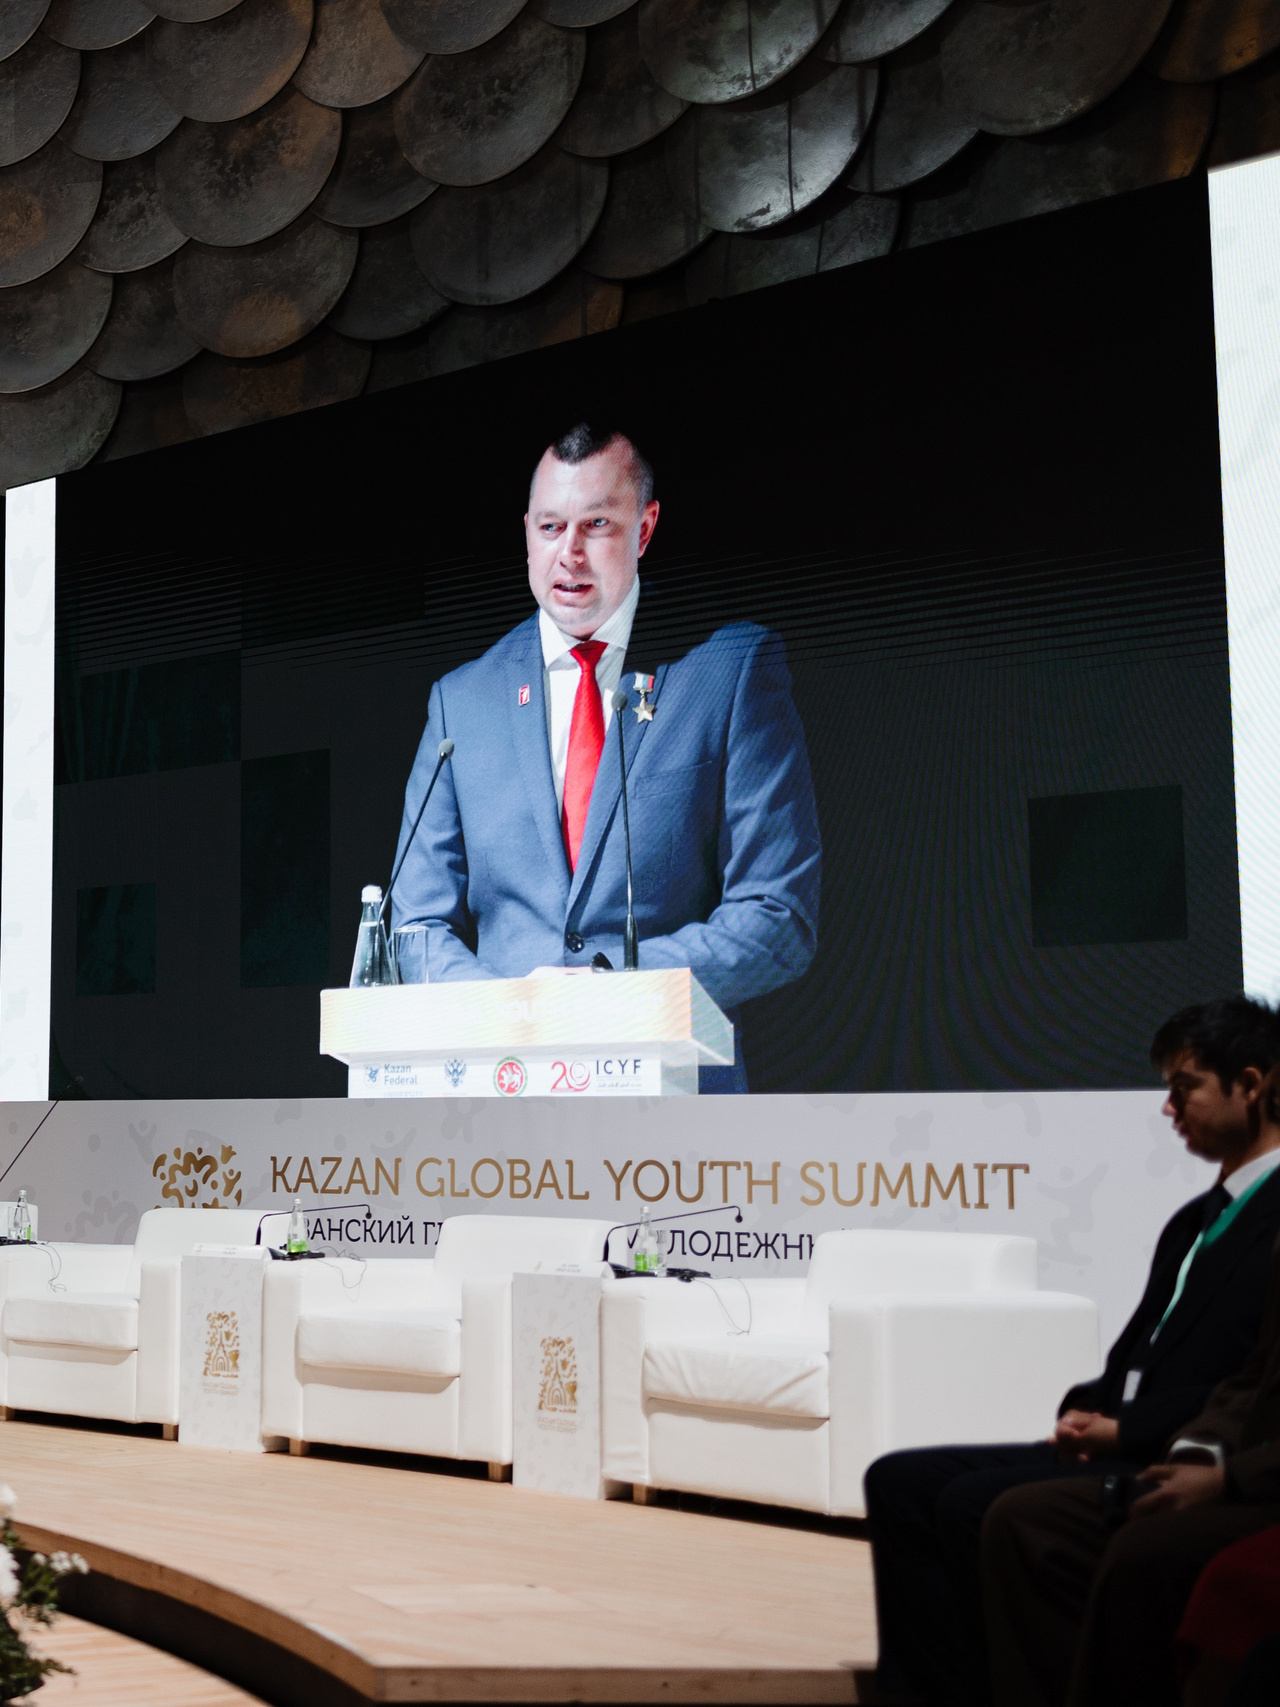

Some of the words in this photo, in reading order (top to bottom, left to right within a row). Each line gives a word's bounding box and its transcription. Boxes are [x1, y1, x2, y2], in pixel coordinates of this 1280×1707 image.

[384, 1063, 412, 1074] Kazan
[596, 1059, 641, 1075] ICYF
[384, 1075, 417, 1085] Federal
[272, 1157, 401, 1196] KAZAN
[416, 1158, 590, 1201] GLOBAL
[604, 1160, 781, 1205] YOUTH
[801, 1162, 1030, 1210] SUMMIT
